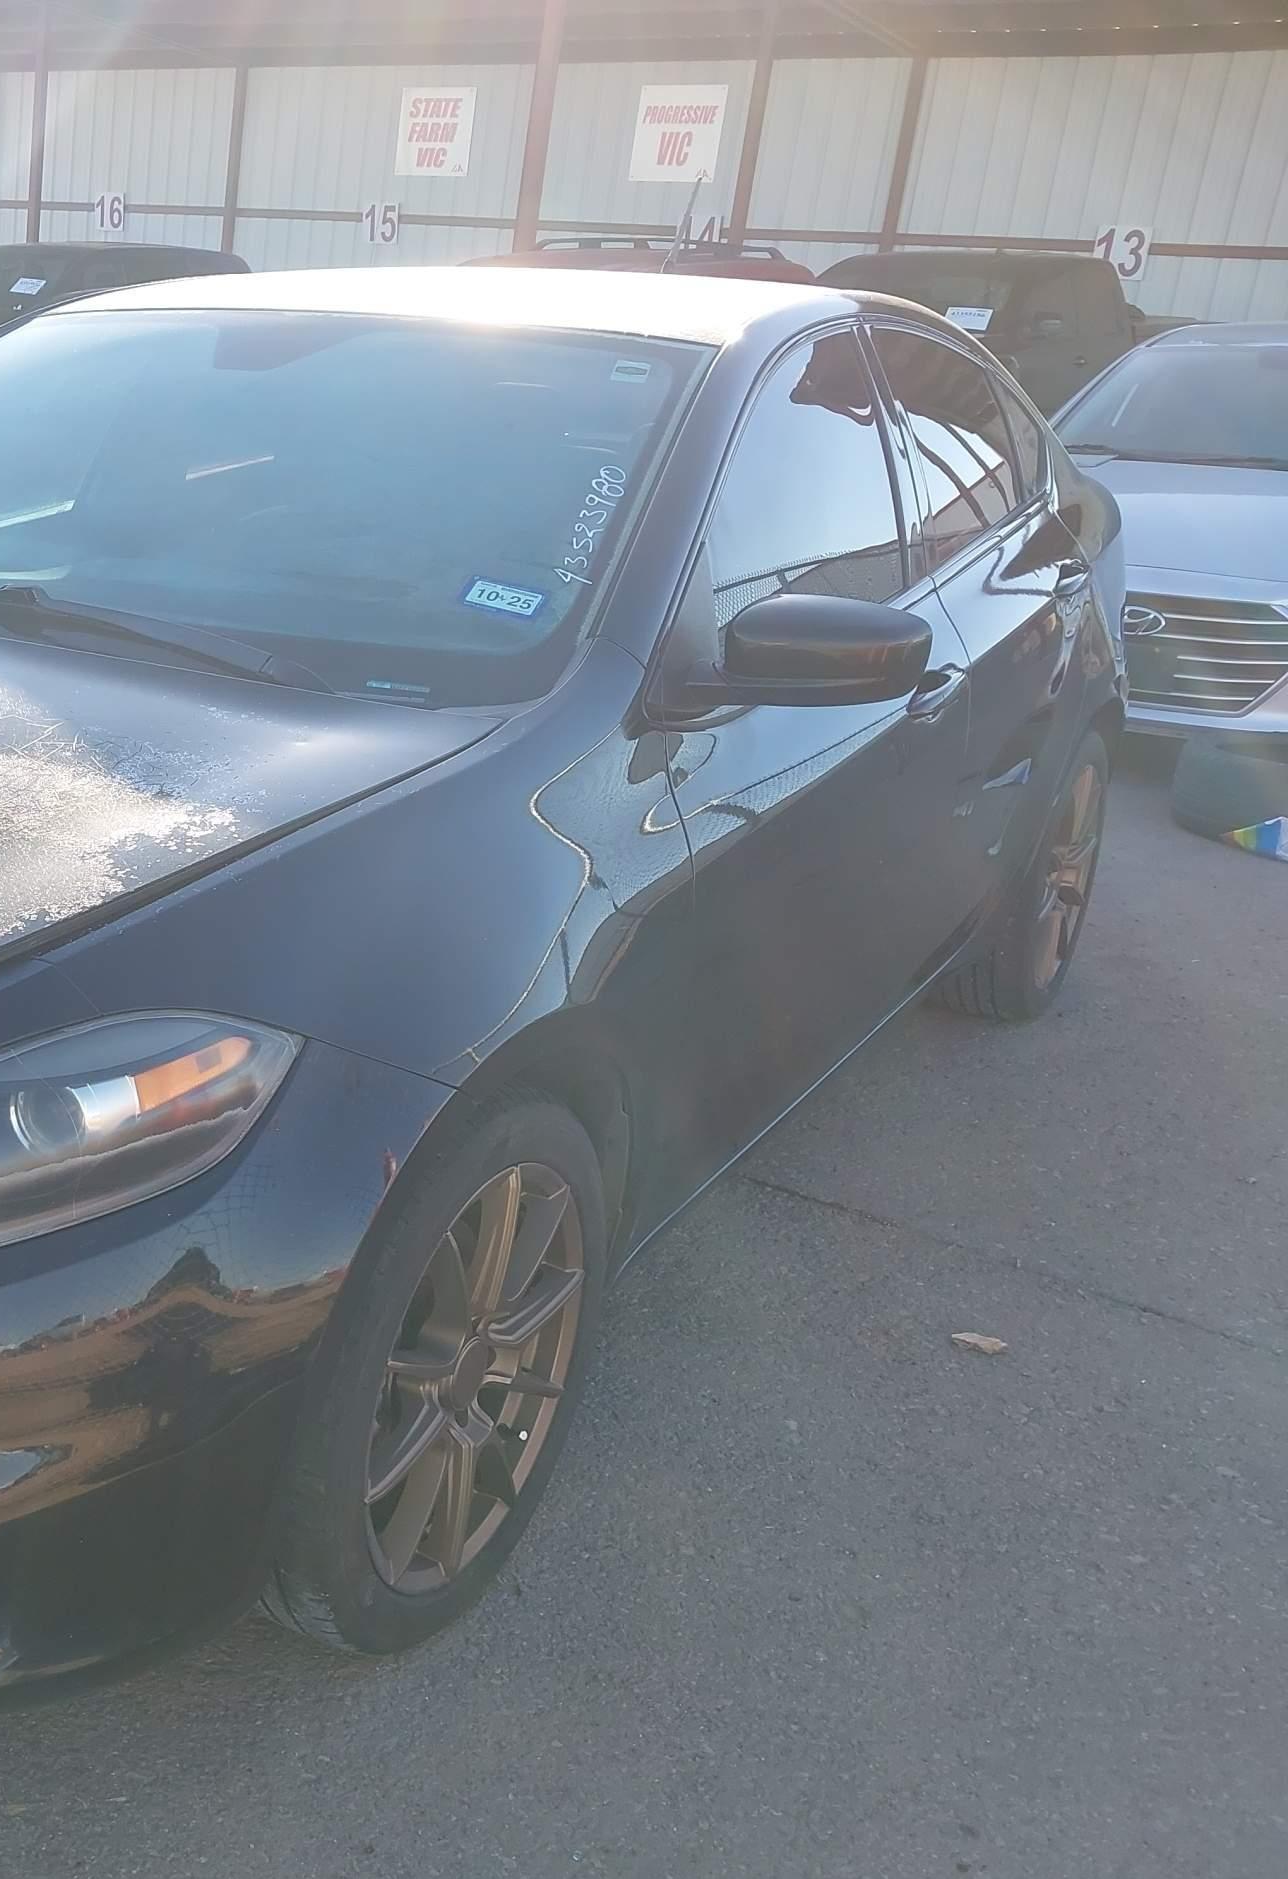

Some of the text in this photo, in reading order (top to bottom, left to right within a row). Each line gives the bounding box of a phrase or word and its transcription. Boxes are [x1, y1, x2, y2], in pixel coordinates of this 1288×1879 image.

[409, 96, 463, 118] STATE
[642, 105, 719, 125] PROGRESSIVE
[407, 121, 459, 143] FARM
[655, 130, 694, 167] VIC
[415, 146, 448, 169] VIC
[95, 194, 123, 229] 16
[364, 204, 397, 242] 15
[1097, 228, 1145, 278] 13
[553, 465, 626, 585] 43523980
